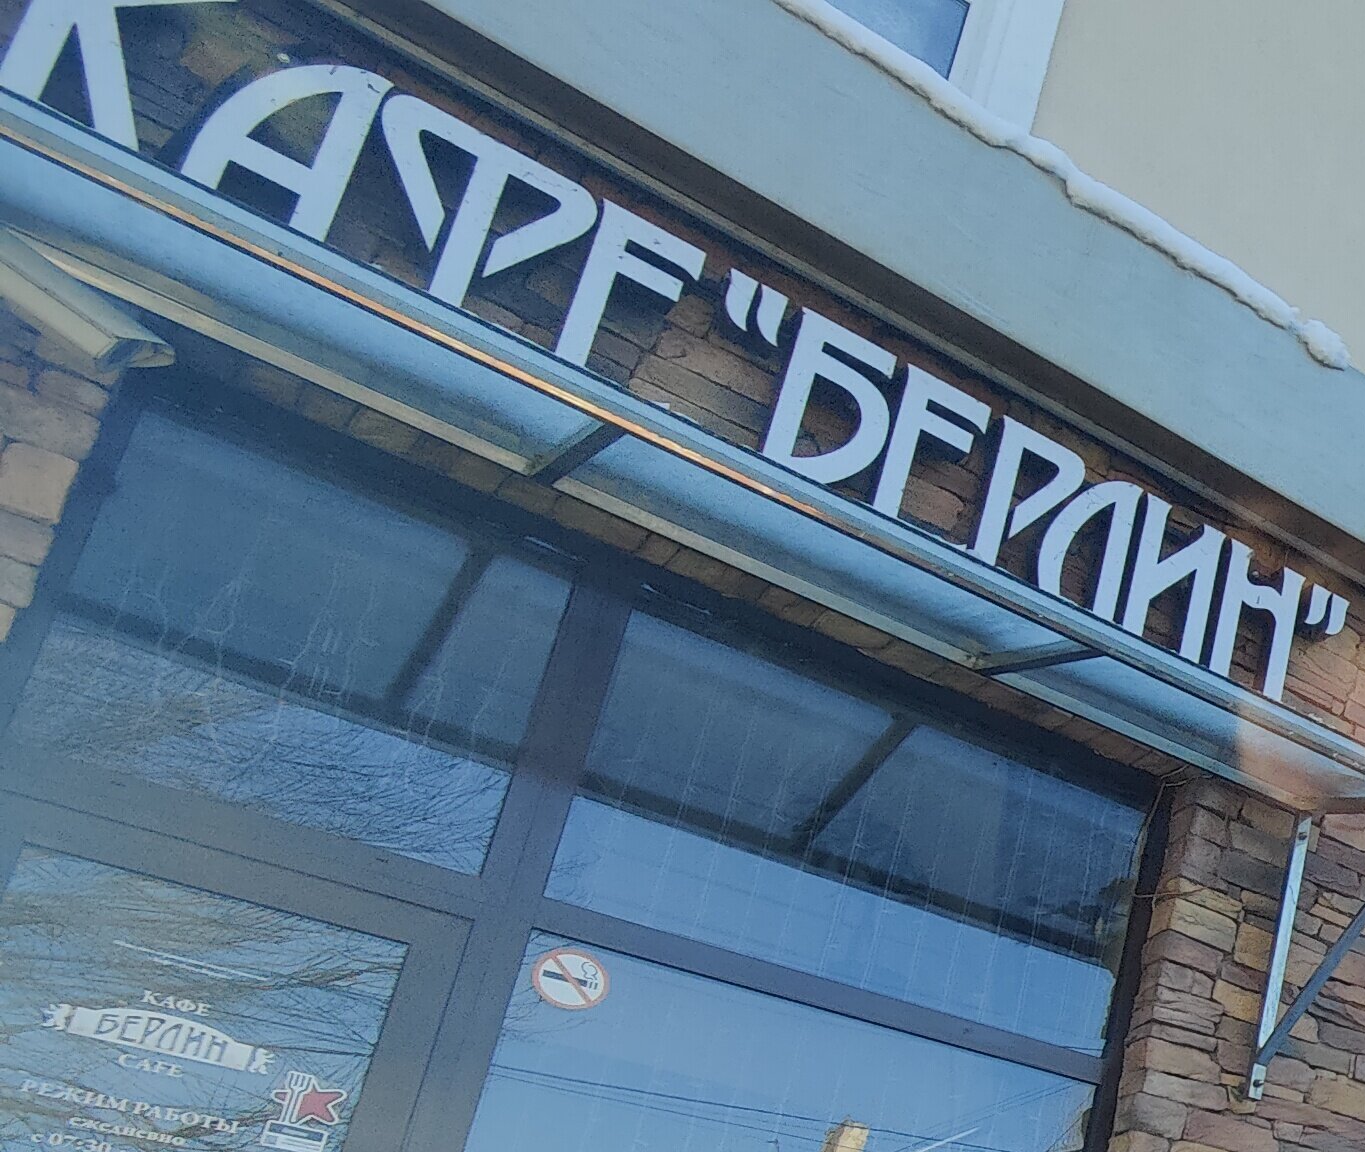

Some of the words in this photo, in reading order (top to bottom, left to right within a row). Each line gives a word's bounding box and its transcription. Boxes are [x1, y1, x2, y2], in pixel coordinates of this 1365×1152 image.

[0, 0, 707, 368] КАФЕ
[140, 990, 212, 1017] КАФЕ
[93, 1013, 229, 1062] БЕРЛИН
[118, 1053, 184, 1078] CAFE
[20, 1079, 128, 1112] РЕЖИМ
[132, 1101, 240, 1133] РАБОТЫ
